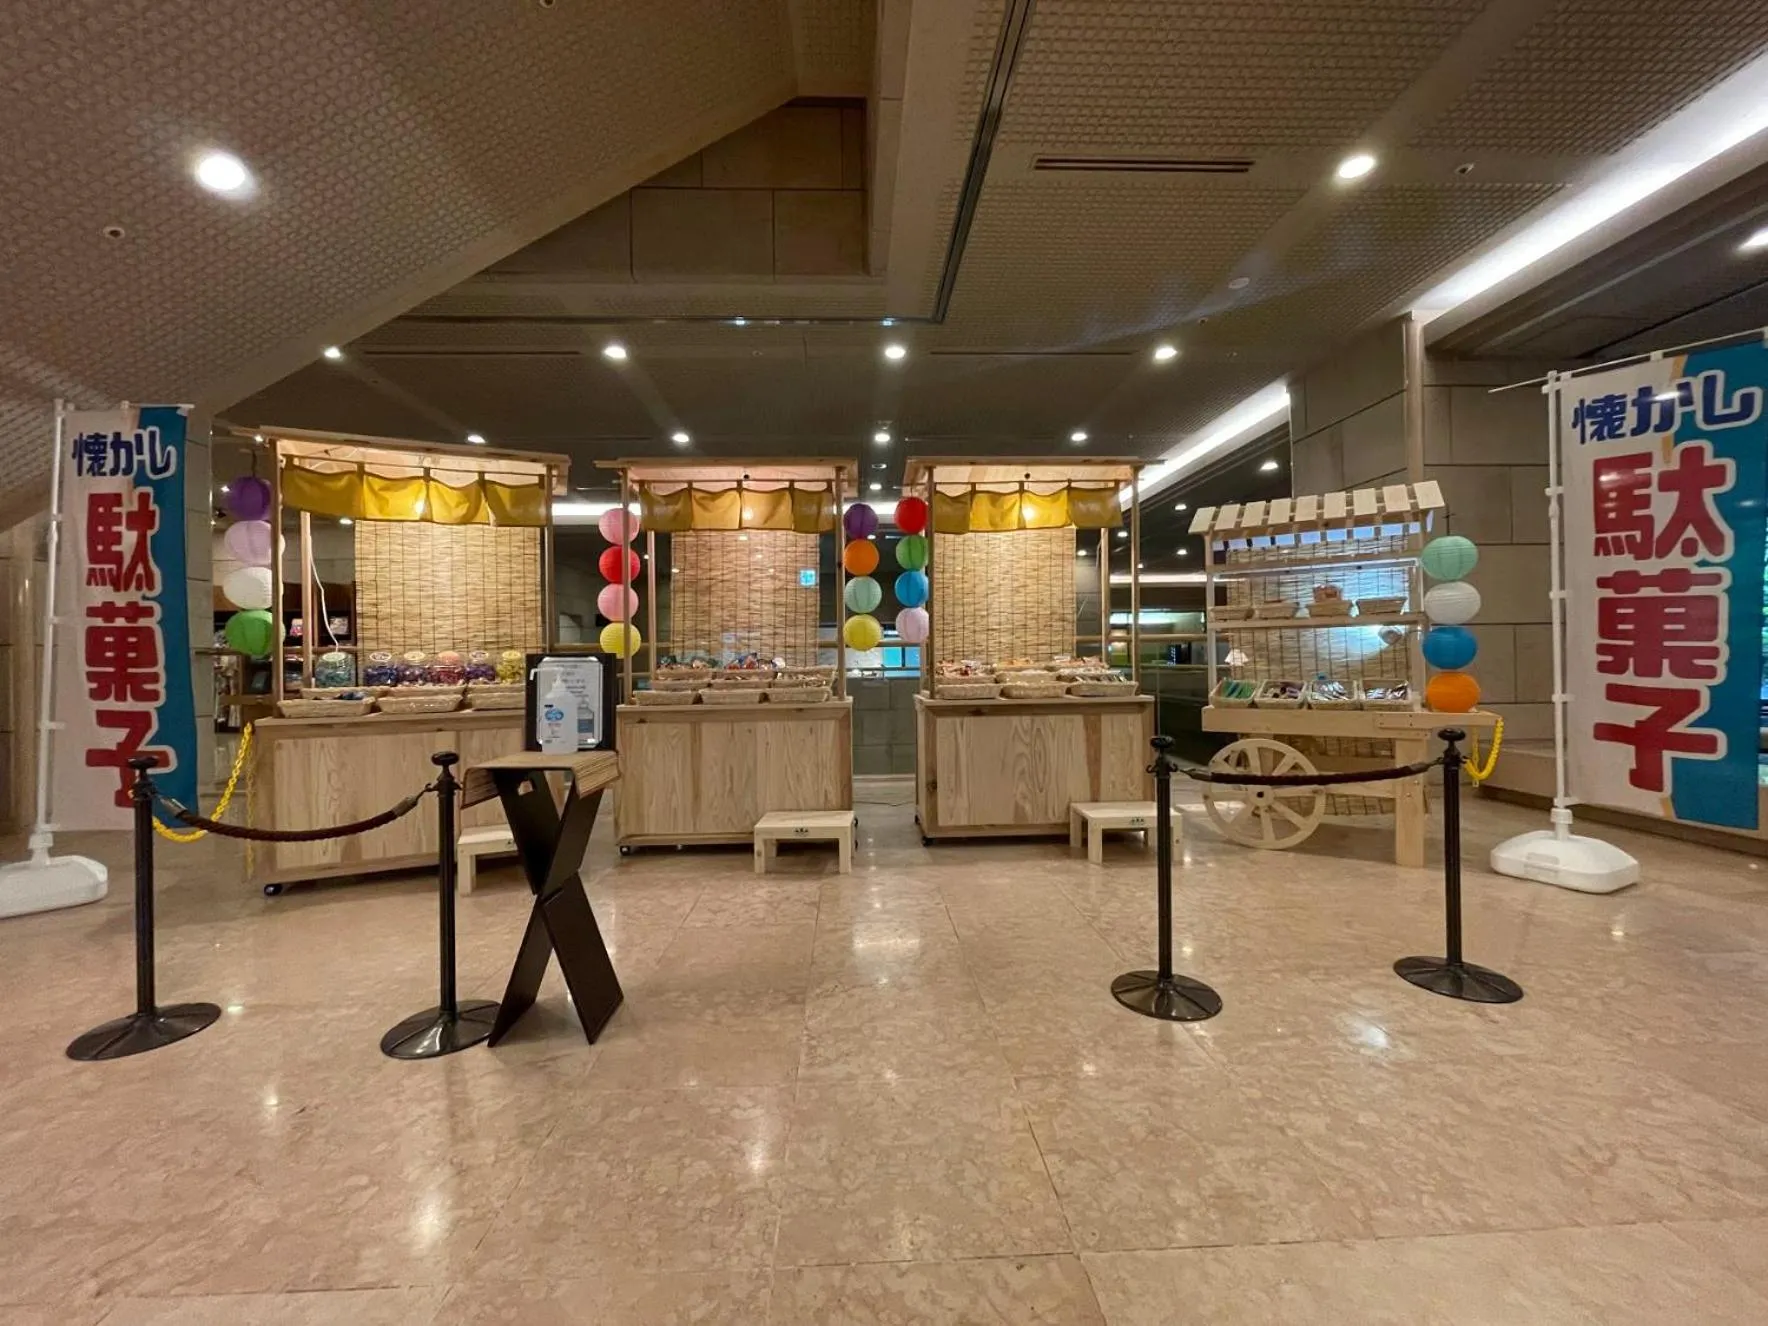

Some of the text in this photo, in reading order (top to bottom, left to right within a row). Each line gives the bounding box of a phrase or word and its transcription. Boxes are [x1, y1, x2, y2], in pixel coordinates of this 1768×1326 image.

[72, 429, 173, 477] 懐かし
[1571, 374, 1756, 444] 懐かし
[85, 492, 171, 808] 駄菓子
[1593, 445, 1727, 793] 駄菓子
